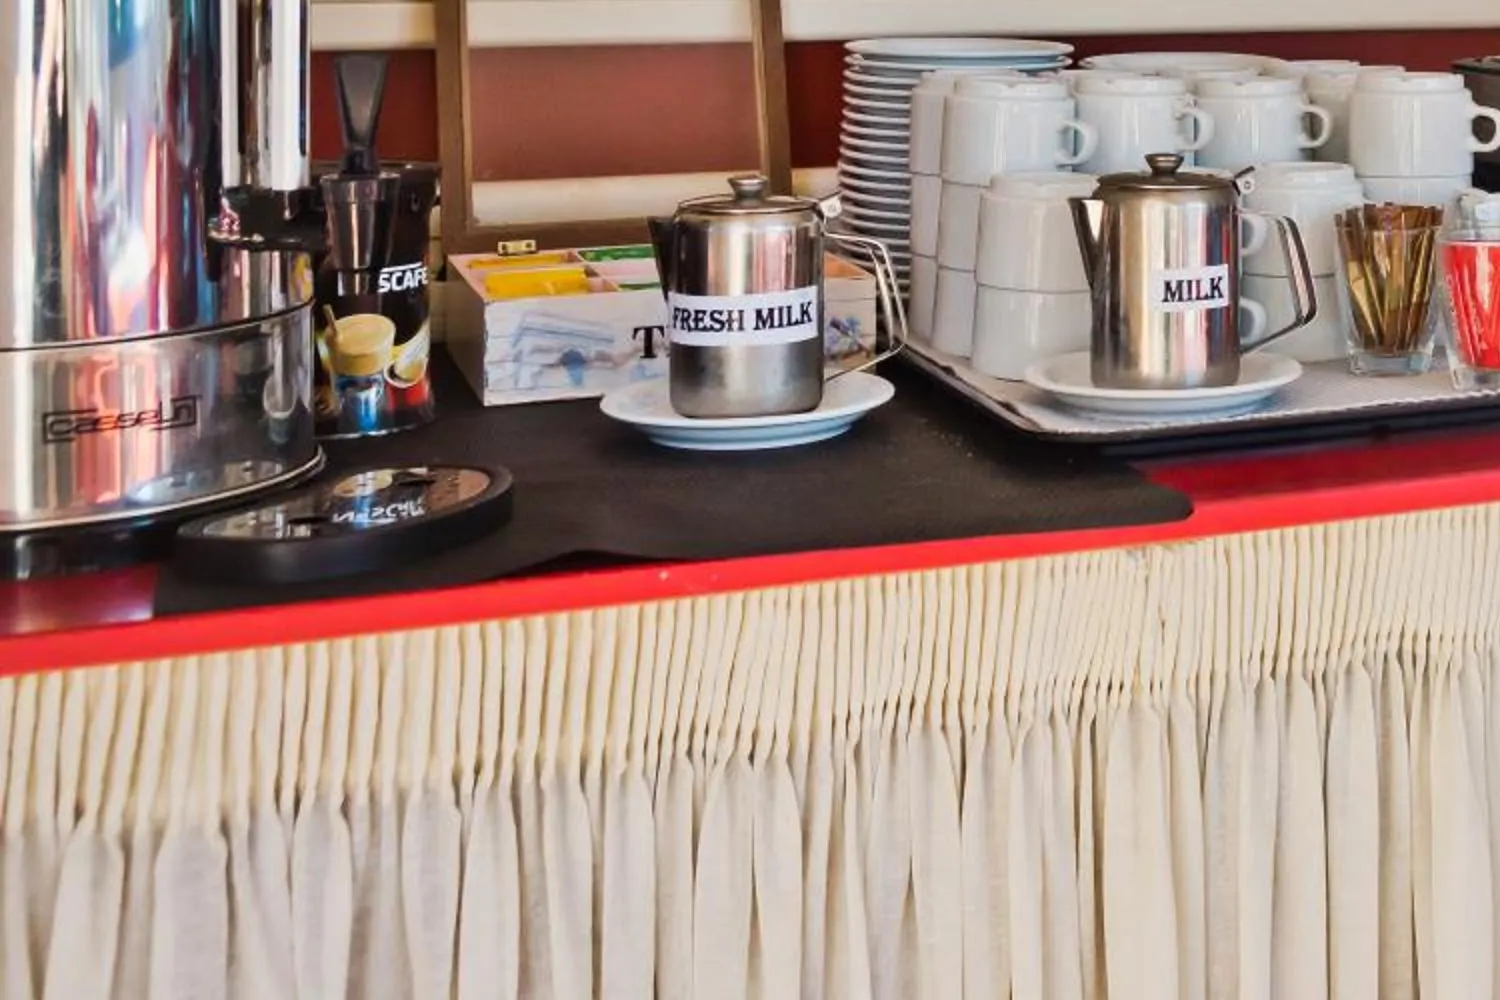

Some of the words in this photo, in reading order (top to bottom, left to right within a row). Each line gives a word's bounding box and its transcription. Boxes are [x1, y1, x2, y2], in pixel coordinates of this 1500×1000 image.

[1161, 275, 1224, 303] MILK
[672, 306, 745, 333] FRESH
[753, 300, 813, 331] MILK
